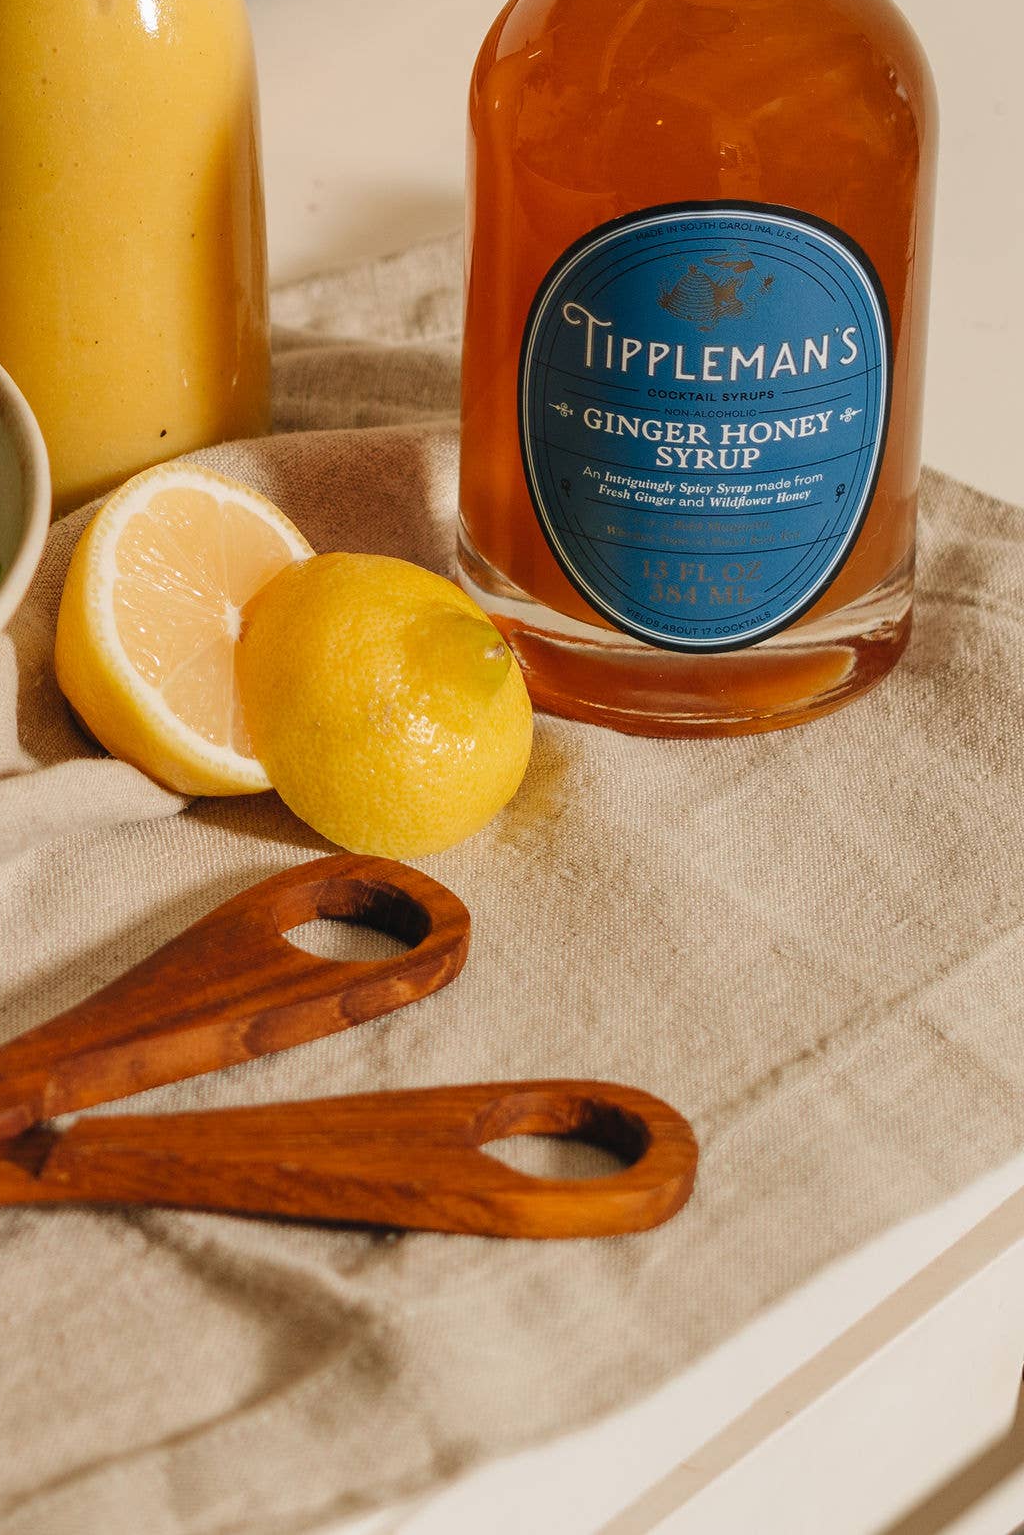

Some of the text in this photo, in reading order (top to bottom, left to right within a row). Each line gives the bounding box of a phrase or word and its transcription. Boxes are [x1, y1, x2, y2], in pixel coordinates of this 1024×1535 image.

[667, 225, 677, 233] IN
[680, 221, 716, 231] SOUTH
[563, 302, 858, 382] TIPPLEMAN'S
[647, 388, 775, 402] COCKTAIL SYRUPS
[664, 408, 757, 419] NON-ALCOHOLIC
[583, 408, 834, 446] GINGER HONEY
[655, 446, 761, 470] SYRUP
[582, 466, 823, 496] An Intriguingly Spicy Syrup made from
[598, 483, 812, 511] Fresh Ginger and Wildflower Honey
[643, 559, 764, 583] 13 FL OZ
[708, 584, 753, 605] ML
[626, 607, 772, 636] YIELDS ABOUT 17 COCKTAILS
